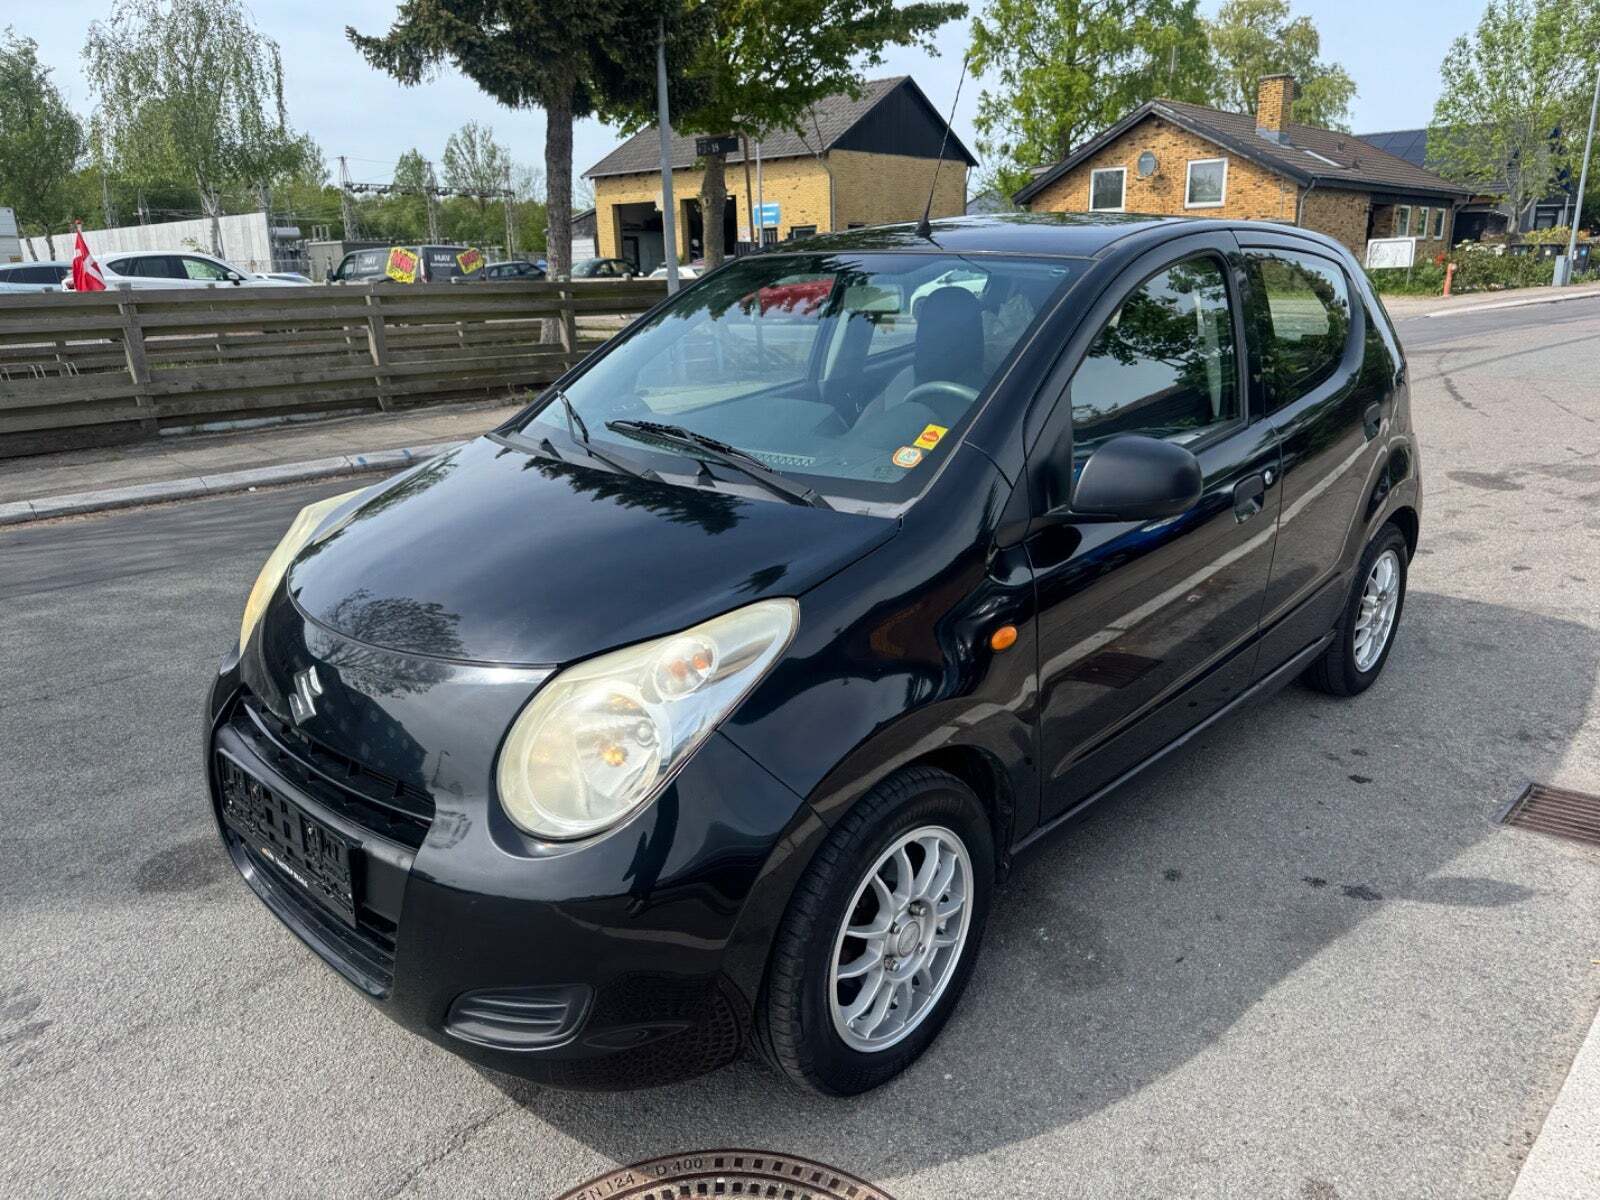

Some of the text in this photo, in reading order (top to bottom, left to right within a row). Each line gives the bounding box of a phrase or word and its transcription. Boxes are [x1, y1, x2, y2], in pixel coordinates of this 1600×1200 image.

[606, 1173, 636, 1193] 124
[655, 1165, 667, 1177] D
[672, 1158, 703, 1173] 400
